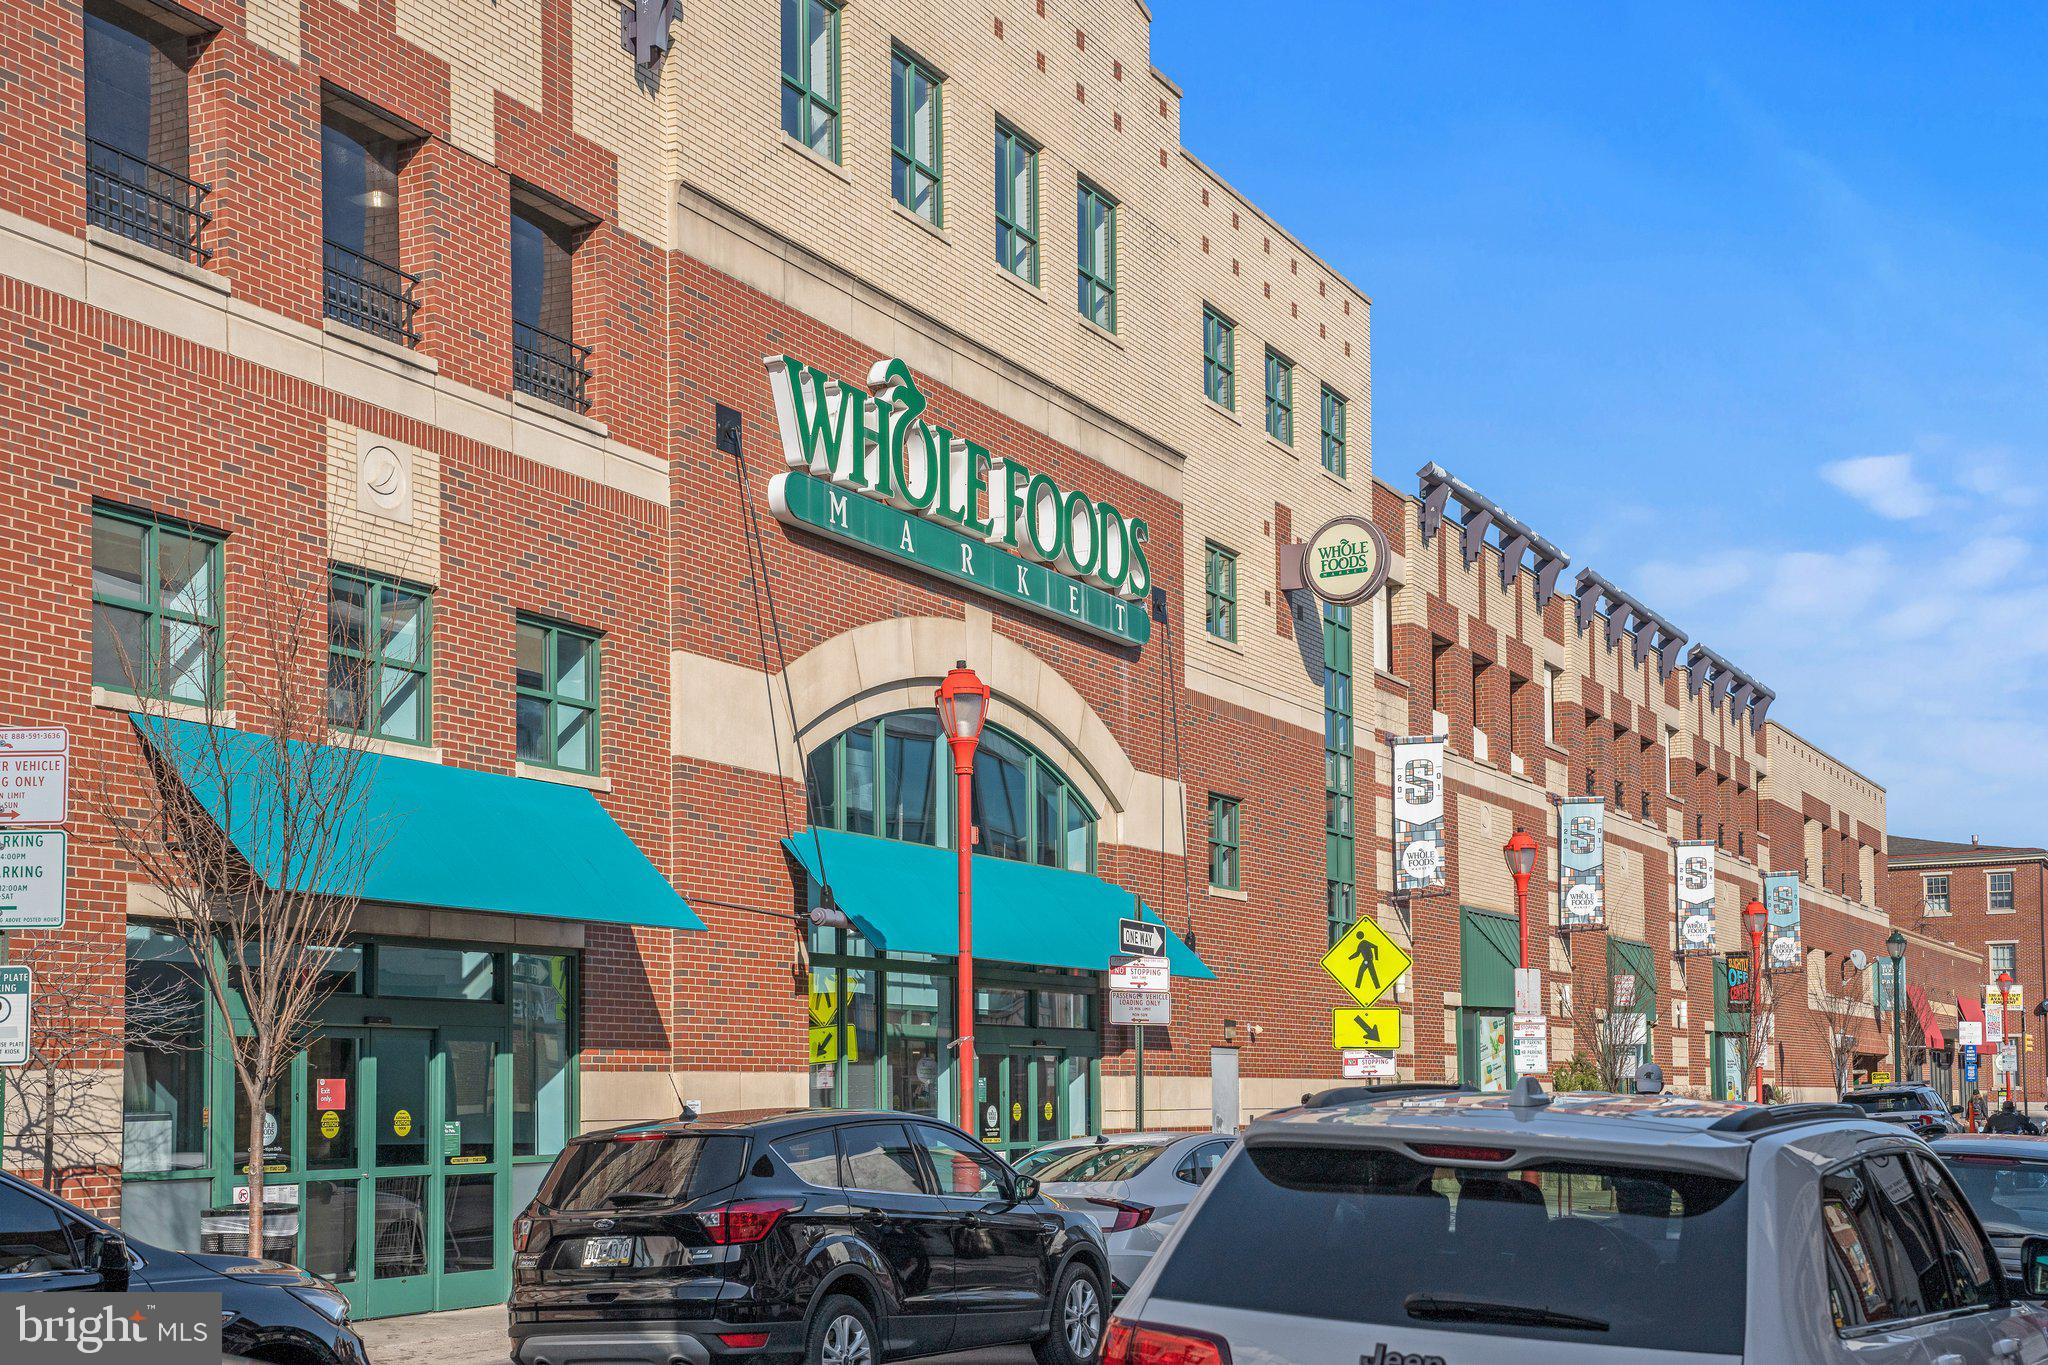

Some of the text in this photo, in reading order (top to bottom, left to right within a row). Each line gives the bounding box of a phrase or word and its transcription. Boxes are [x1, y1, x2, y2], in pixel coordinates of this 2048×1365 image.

[765, 356, 1152, 600] WHOLE FOODS
[1318, 539, 1369, 560] WHOLE
[829, 490, 1127, 632] MARKET
[1321, 554, 1367, 572] FOODS
[1322, 568, 1366, 577] MARKET
[15, 760, 60, 771] VEHICLE
[15, 776, 45, 787] ONLY
[1405, 759, 1434, 805] S
[1570, 816, 1596, 854] S
[1407, 848, 1436, 860] WHOLE
[1408, 859, 1435, 867] FOODS
[1685, 857, 1708, 890] S
[1570, 890, 1595, 900] WHOLE
[1686, 920, 1708, 929] WHOLE
[1125, 929, 1153, 947] ONE WAY
[1114, 966, 1162, 976] NO STOPPING
[3, 973, 28, 982] PLATE
[1728, 968, 1748, 987] OFF
[1146, 993, 1168, 1001] VEHICLE
